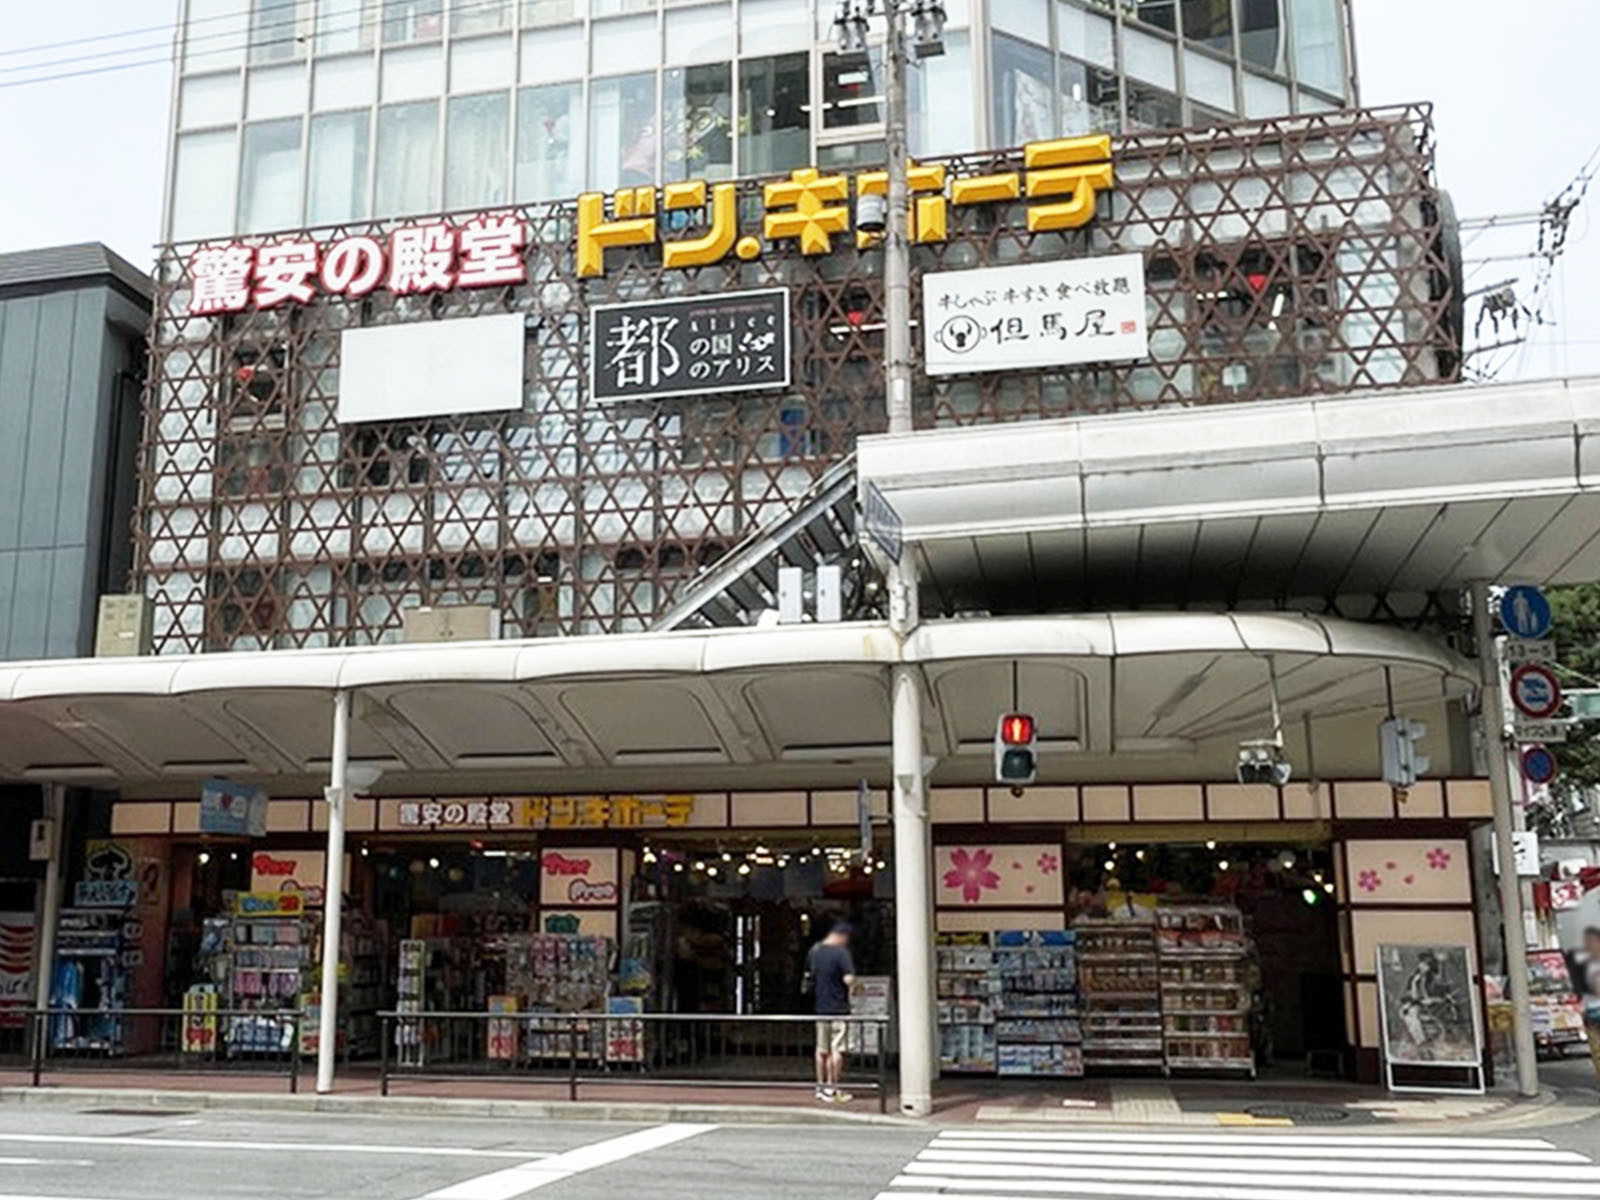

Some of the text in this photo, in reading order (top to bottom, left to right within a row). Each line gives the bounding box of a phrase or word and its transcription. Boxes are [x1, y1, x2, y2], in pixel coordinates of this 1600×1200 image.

[188, 211, 528, 315] 驚安の殿堂
[1056, 276, 1132, 301] 食べ放題
[990, 309, 1115, 345] 但馬屋
[602, 315, 681, 388] 都
[688, 333, 733, 356] の国
[688, 355, 776, 379] のアリス
